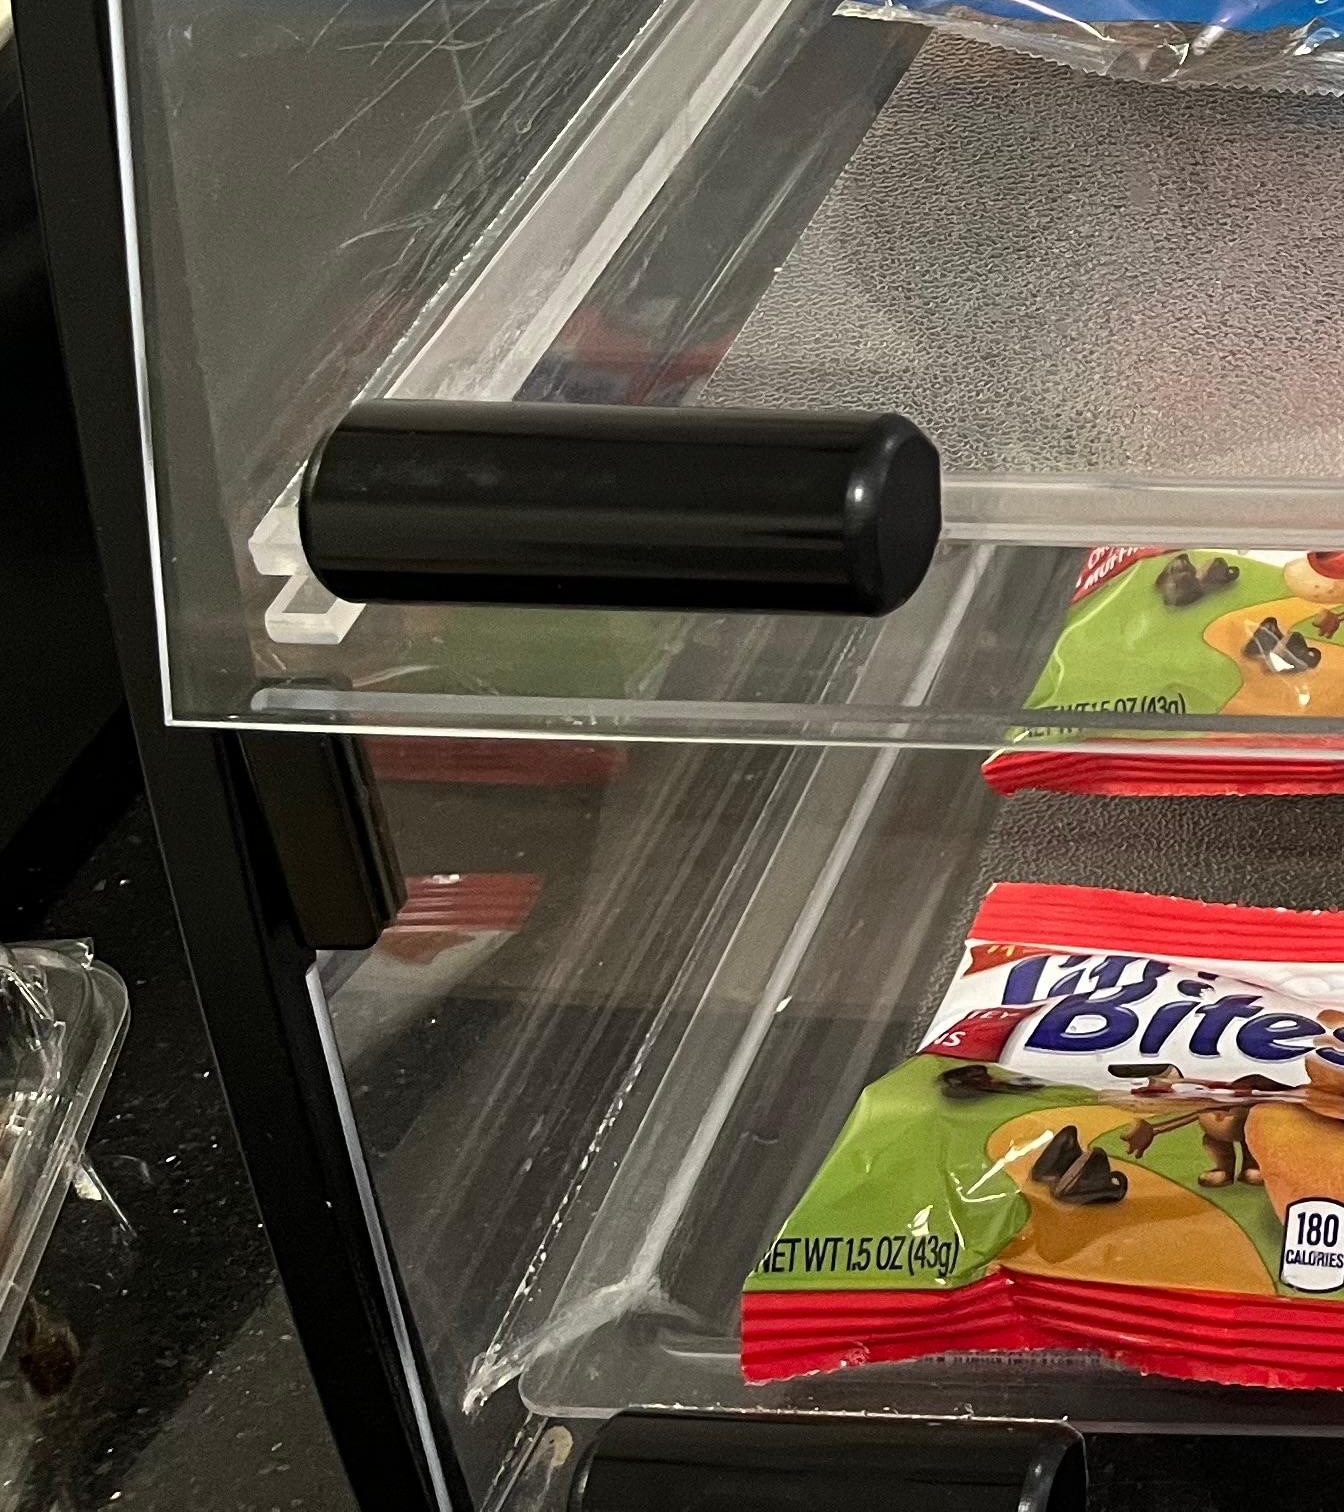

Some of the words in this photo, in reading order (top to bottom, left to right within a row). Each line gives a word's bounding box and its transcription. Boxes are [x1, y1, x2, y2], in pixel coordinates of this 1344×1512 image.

[1297, 1211, 1340, 1248] 180
[804, 1237, 844, 1272] WT
[846, 1237, 873, 1272] 1.5
[876, 1235, 907, 1271] OZ
[907, 1233, 960, 1277] (43g)
[1285, 1248, 1344, 1269] CALORIES
